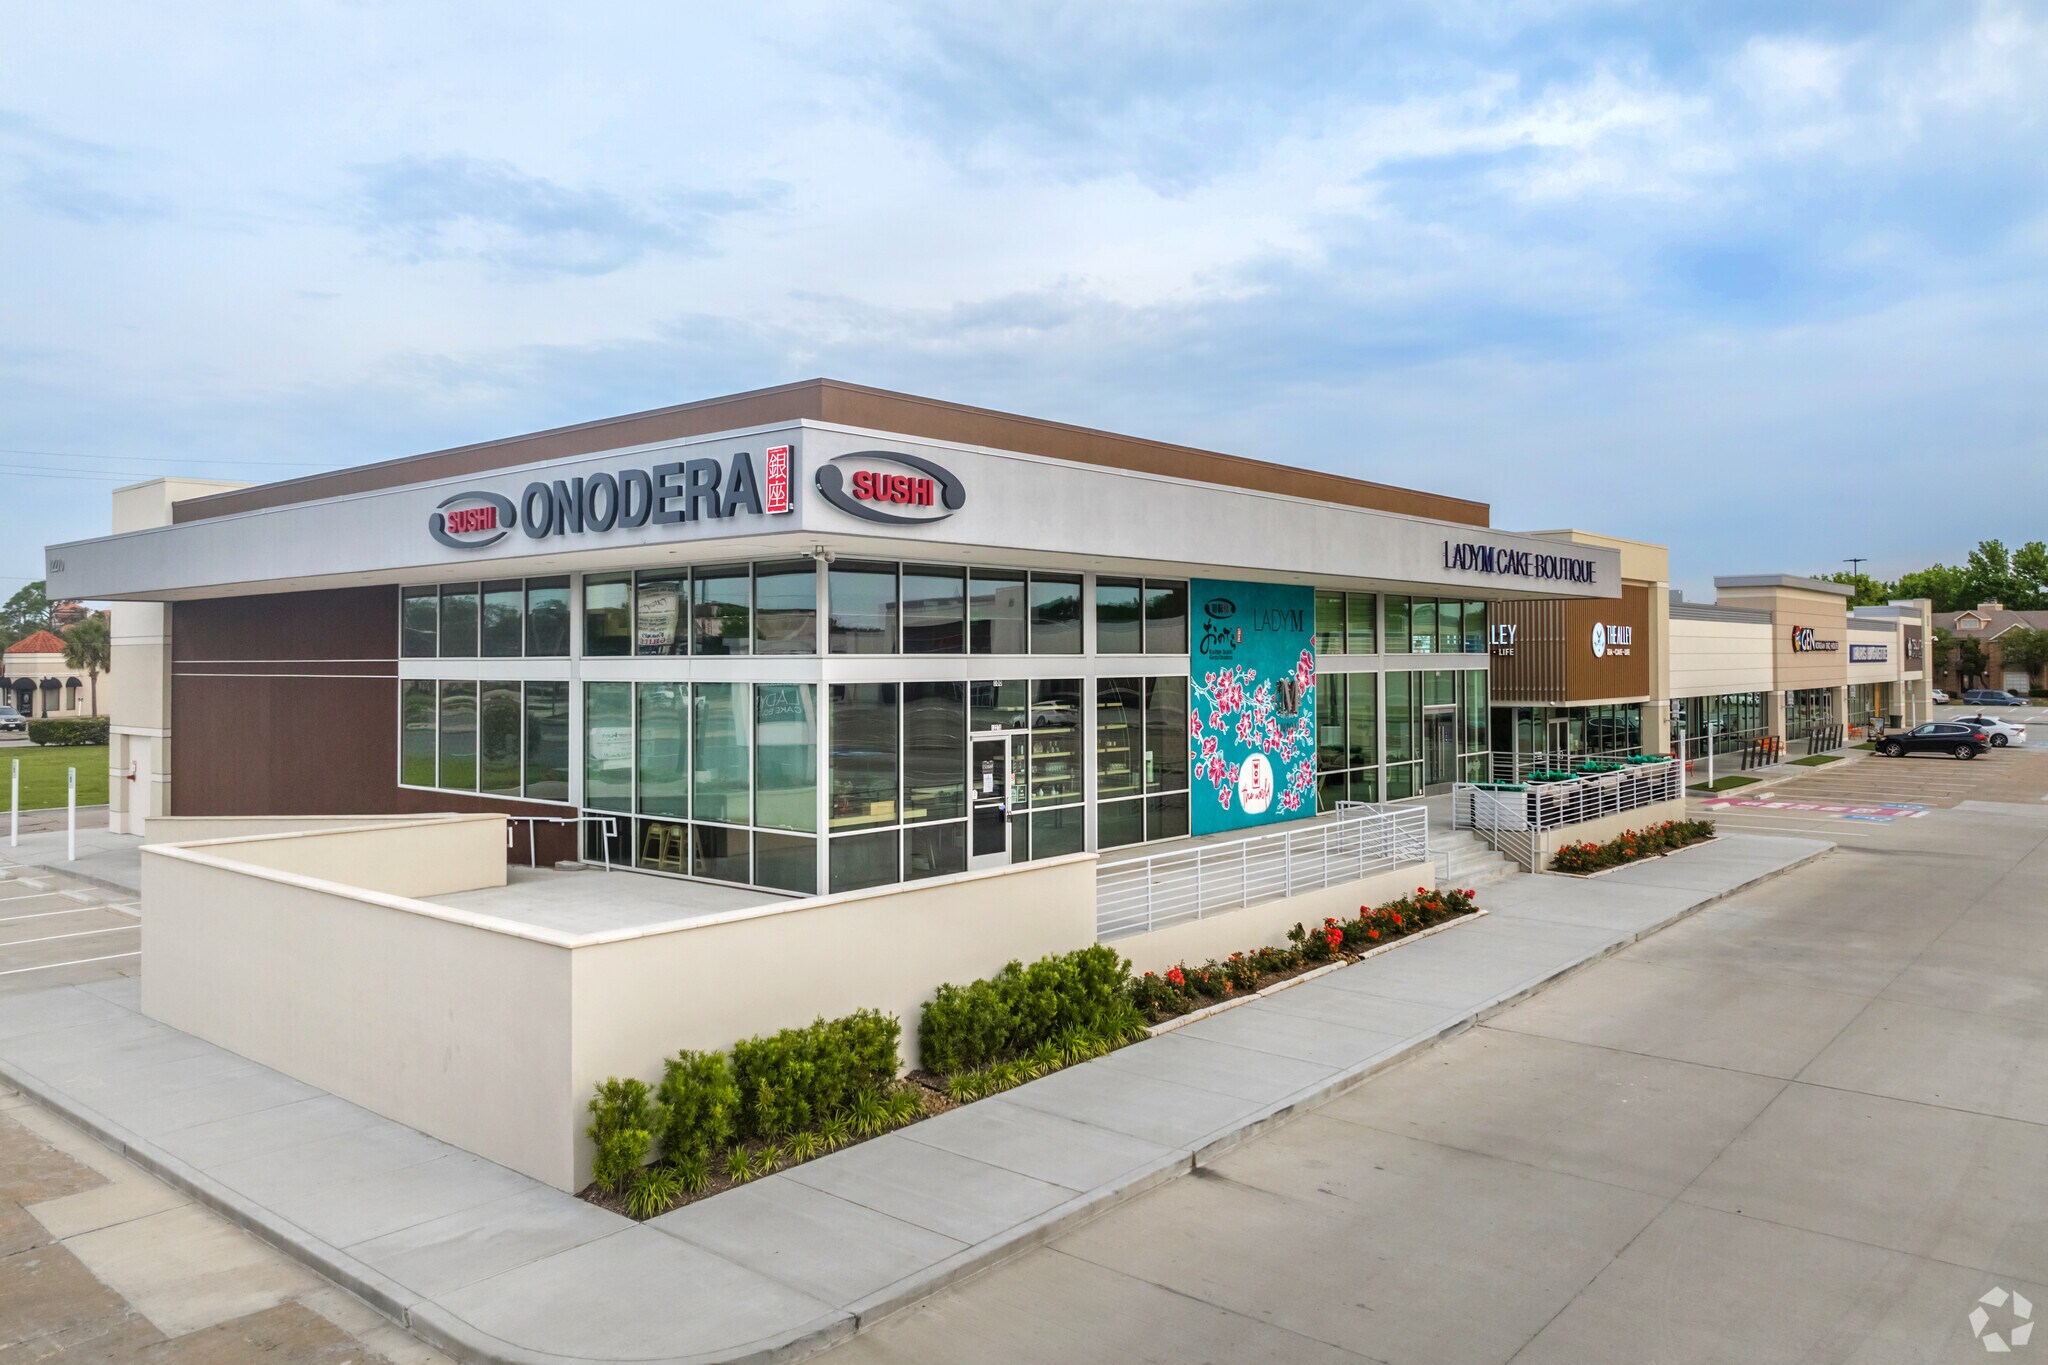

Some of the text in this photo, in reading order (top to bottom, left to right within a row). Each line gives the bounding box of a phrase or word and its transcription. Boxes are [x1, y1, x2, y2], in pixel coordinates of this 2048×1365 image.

[448, 452, 763, 539] SUSHI ONODERA
[768, 452, 788, 510] 銀座
[852, 470, 935, 507] SUSHI
[1497, 549, 1534, 577] CAKE
[1535, 554, 1597, 584] BOUTIQUE
[1489, 624, 1516, 645] LEY
[1606, 625, 1632, 645] THE ALLEY
[1801, 628, 1815, 651] GEN
[1498, 648, 1515, 656] LIFE
